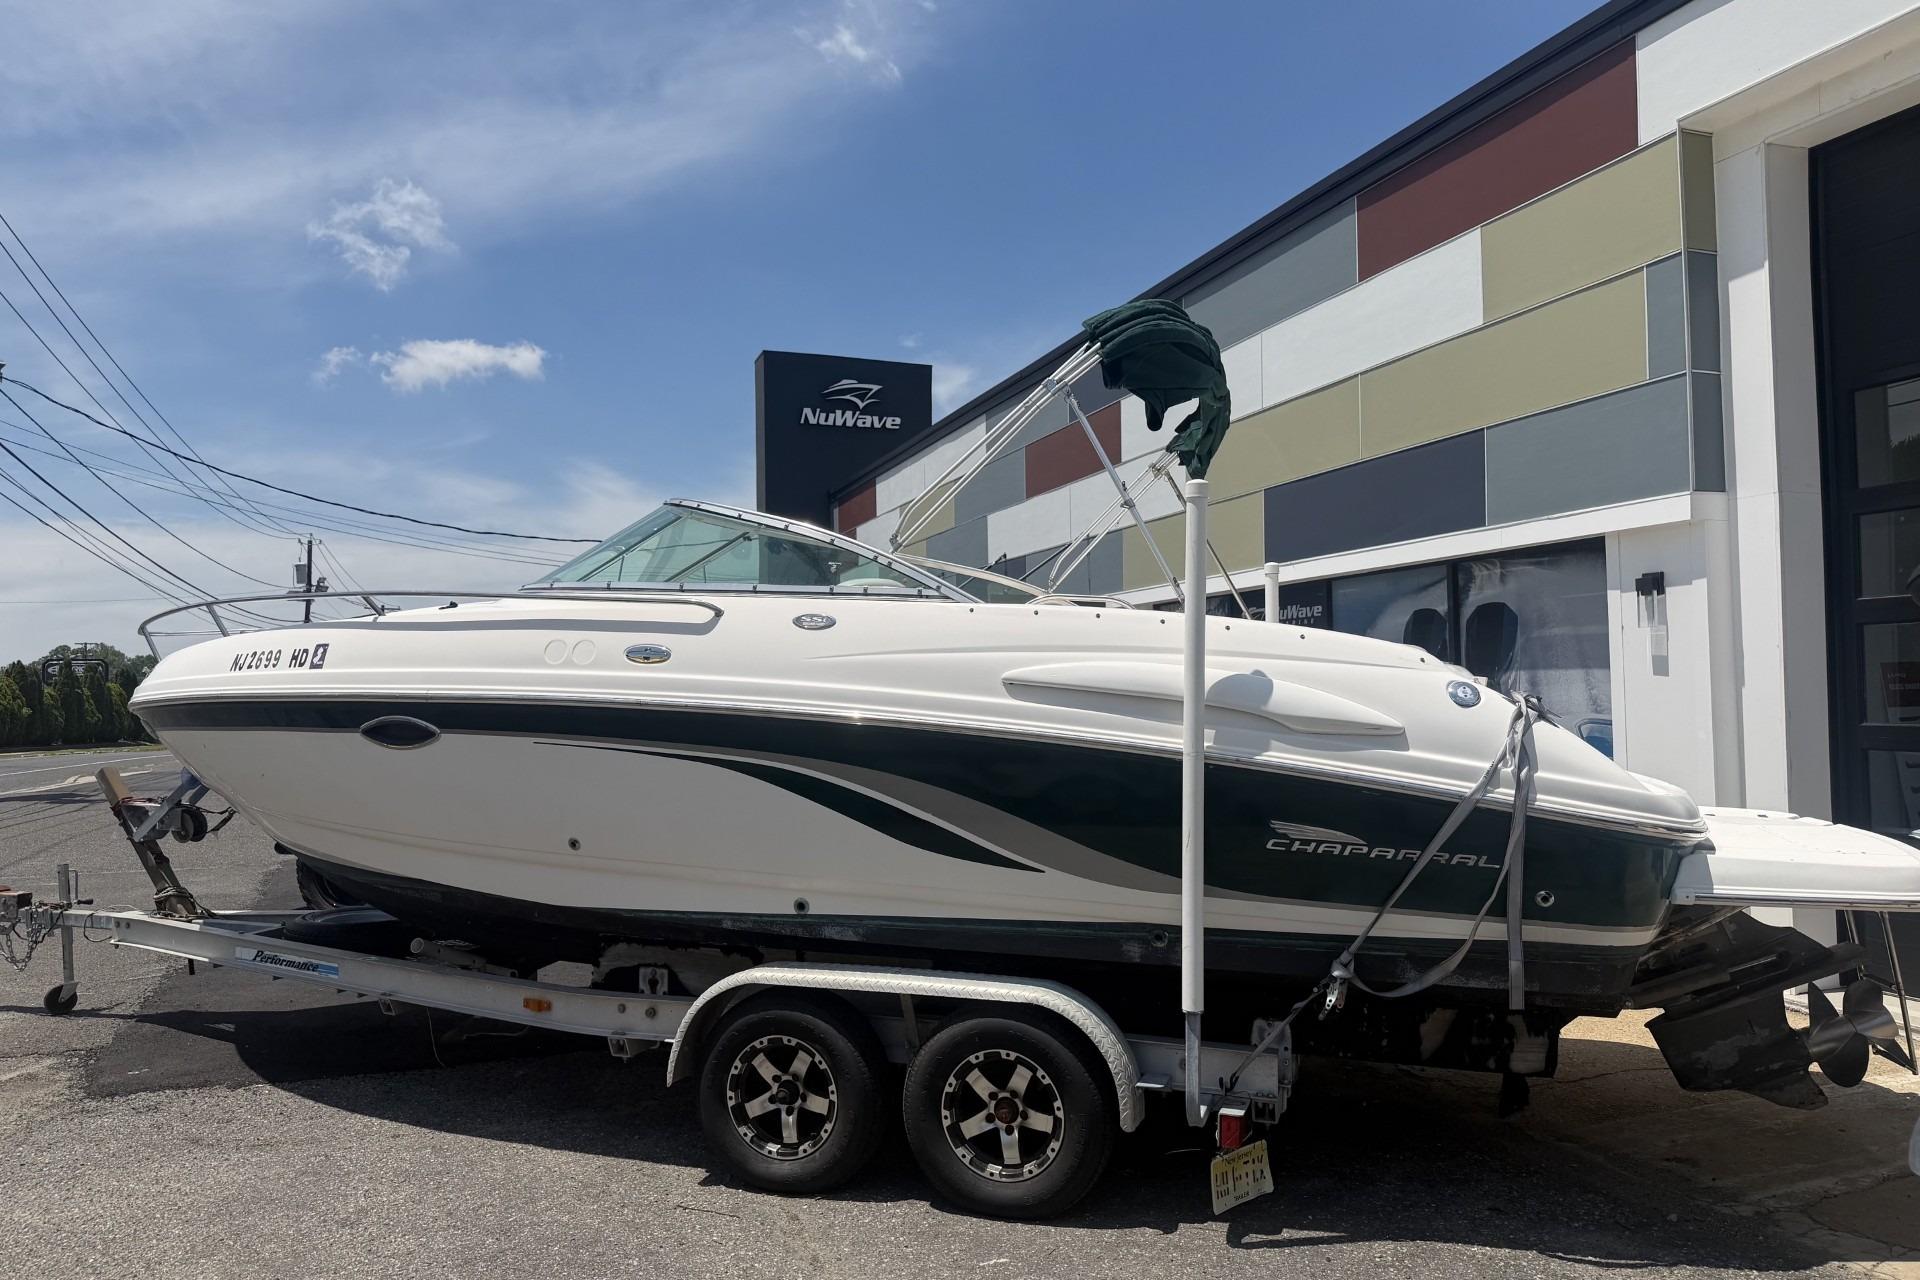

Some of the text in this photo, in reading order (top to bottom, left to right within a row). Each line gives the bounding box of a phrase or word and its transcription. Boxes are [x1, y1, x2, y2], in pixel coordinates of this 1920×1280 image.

[800, 407, 901, 429] NuWave
[1279, 604, 1322, 620] uWave
[230, 649, 309, 672] NJ2699 HD
[1266, 839, 1500, 869] CHAPARRAL
[253, 950, 319, 972] Performance
